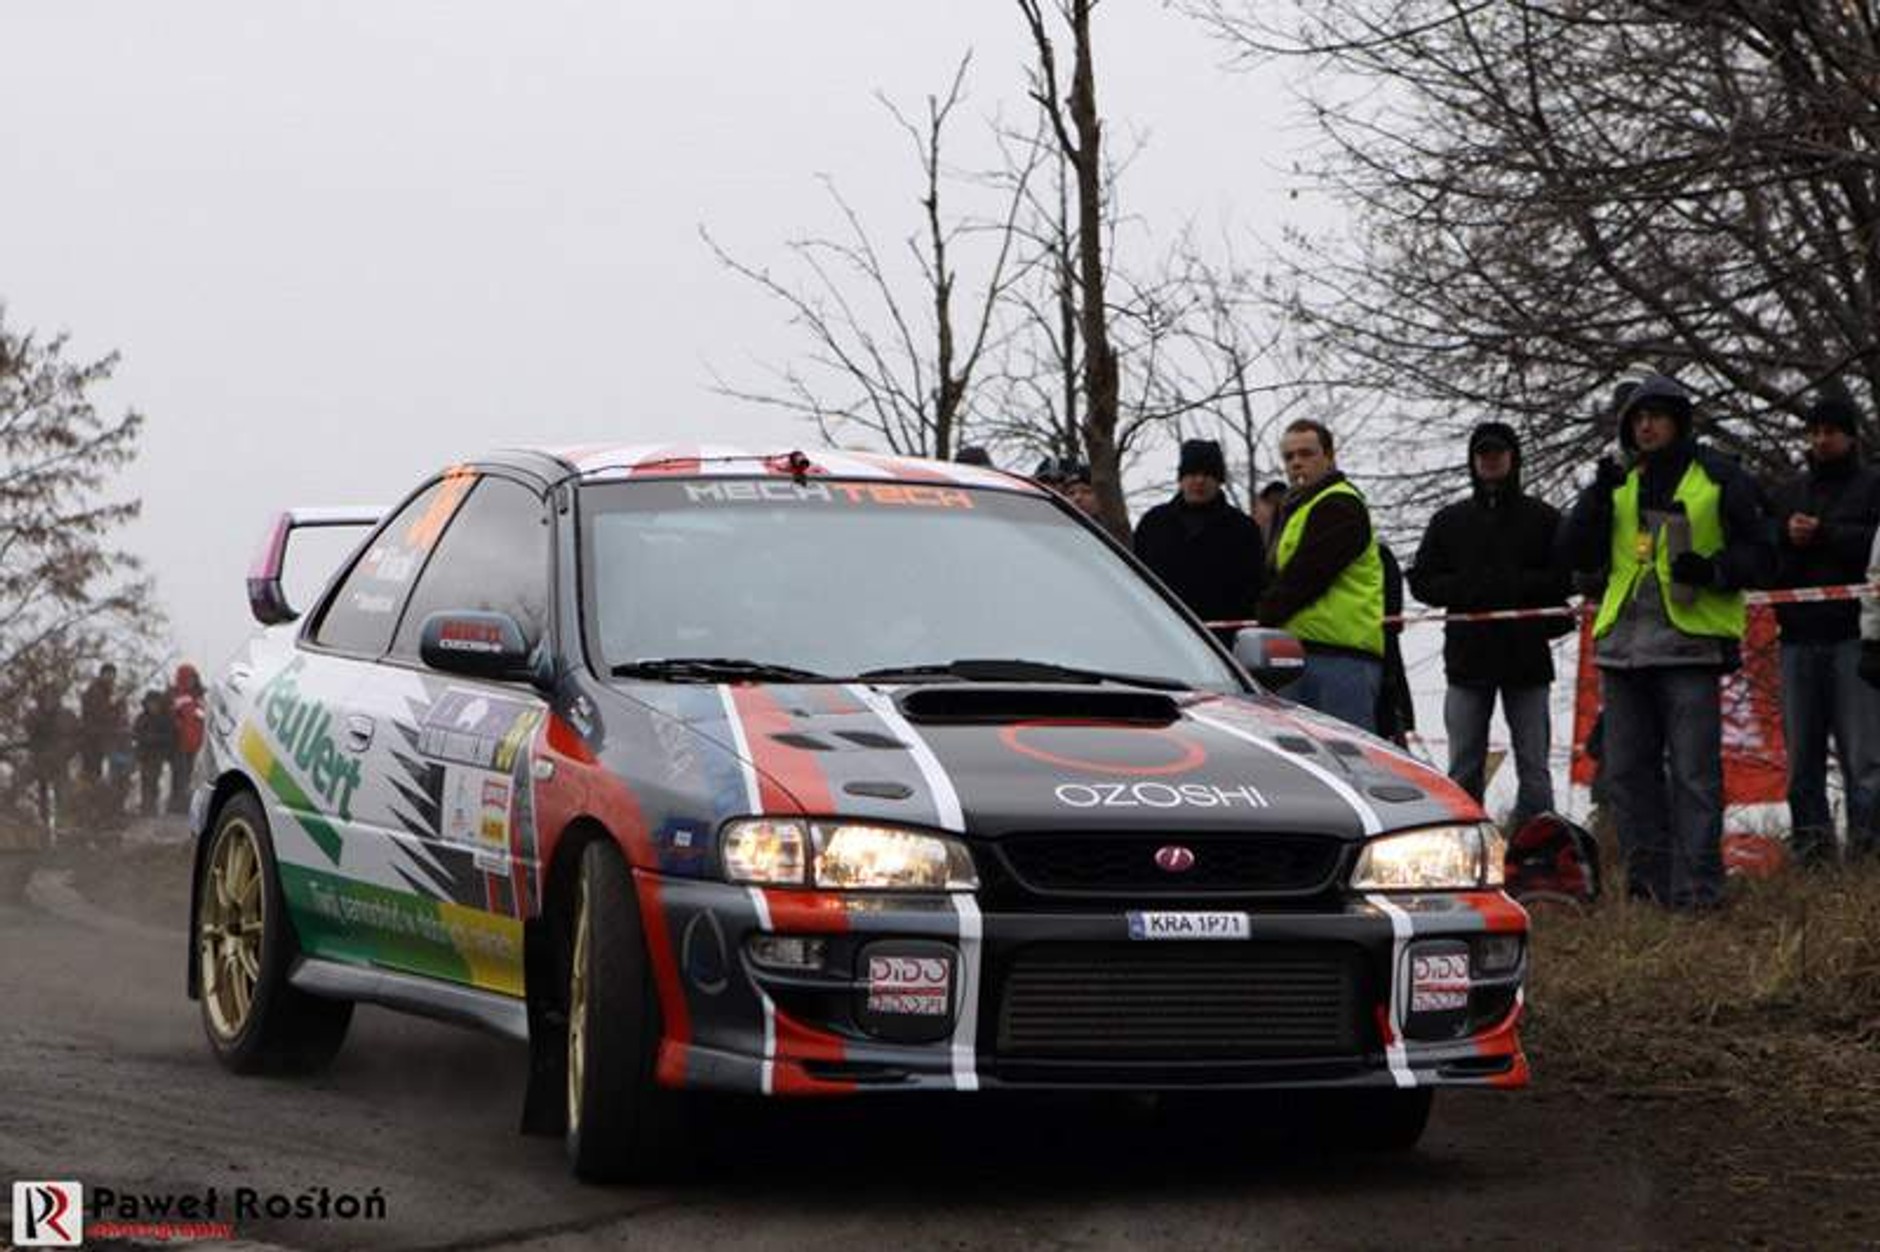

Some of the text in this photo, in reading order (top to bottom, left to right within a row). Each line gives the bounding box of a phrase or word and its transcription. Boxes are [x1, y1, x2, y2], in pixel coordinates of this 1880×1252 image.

[1054, 782, 1269, 808] OZOSHI
[1150, 915, 1240, 932] KRA 1P71
